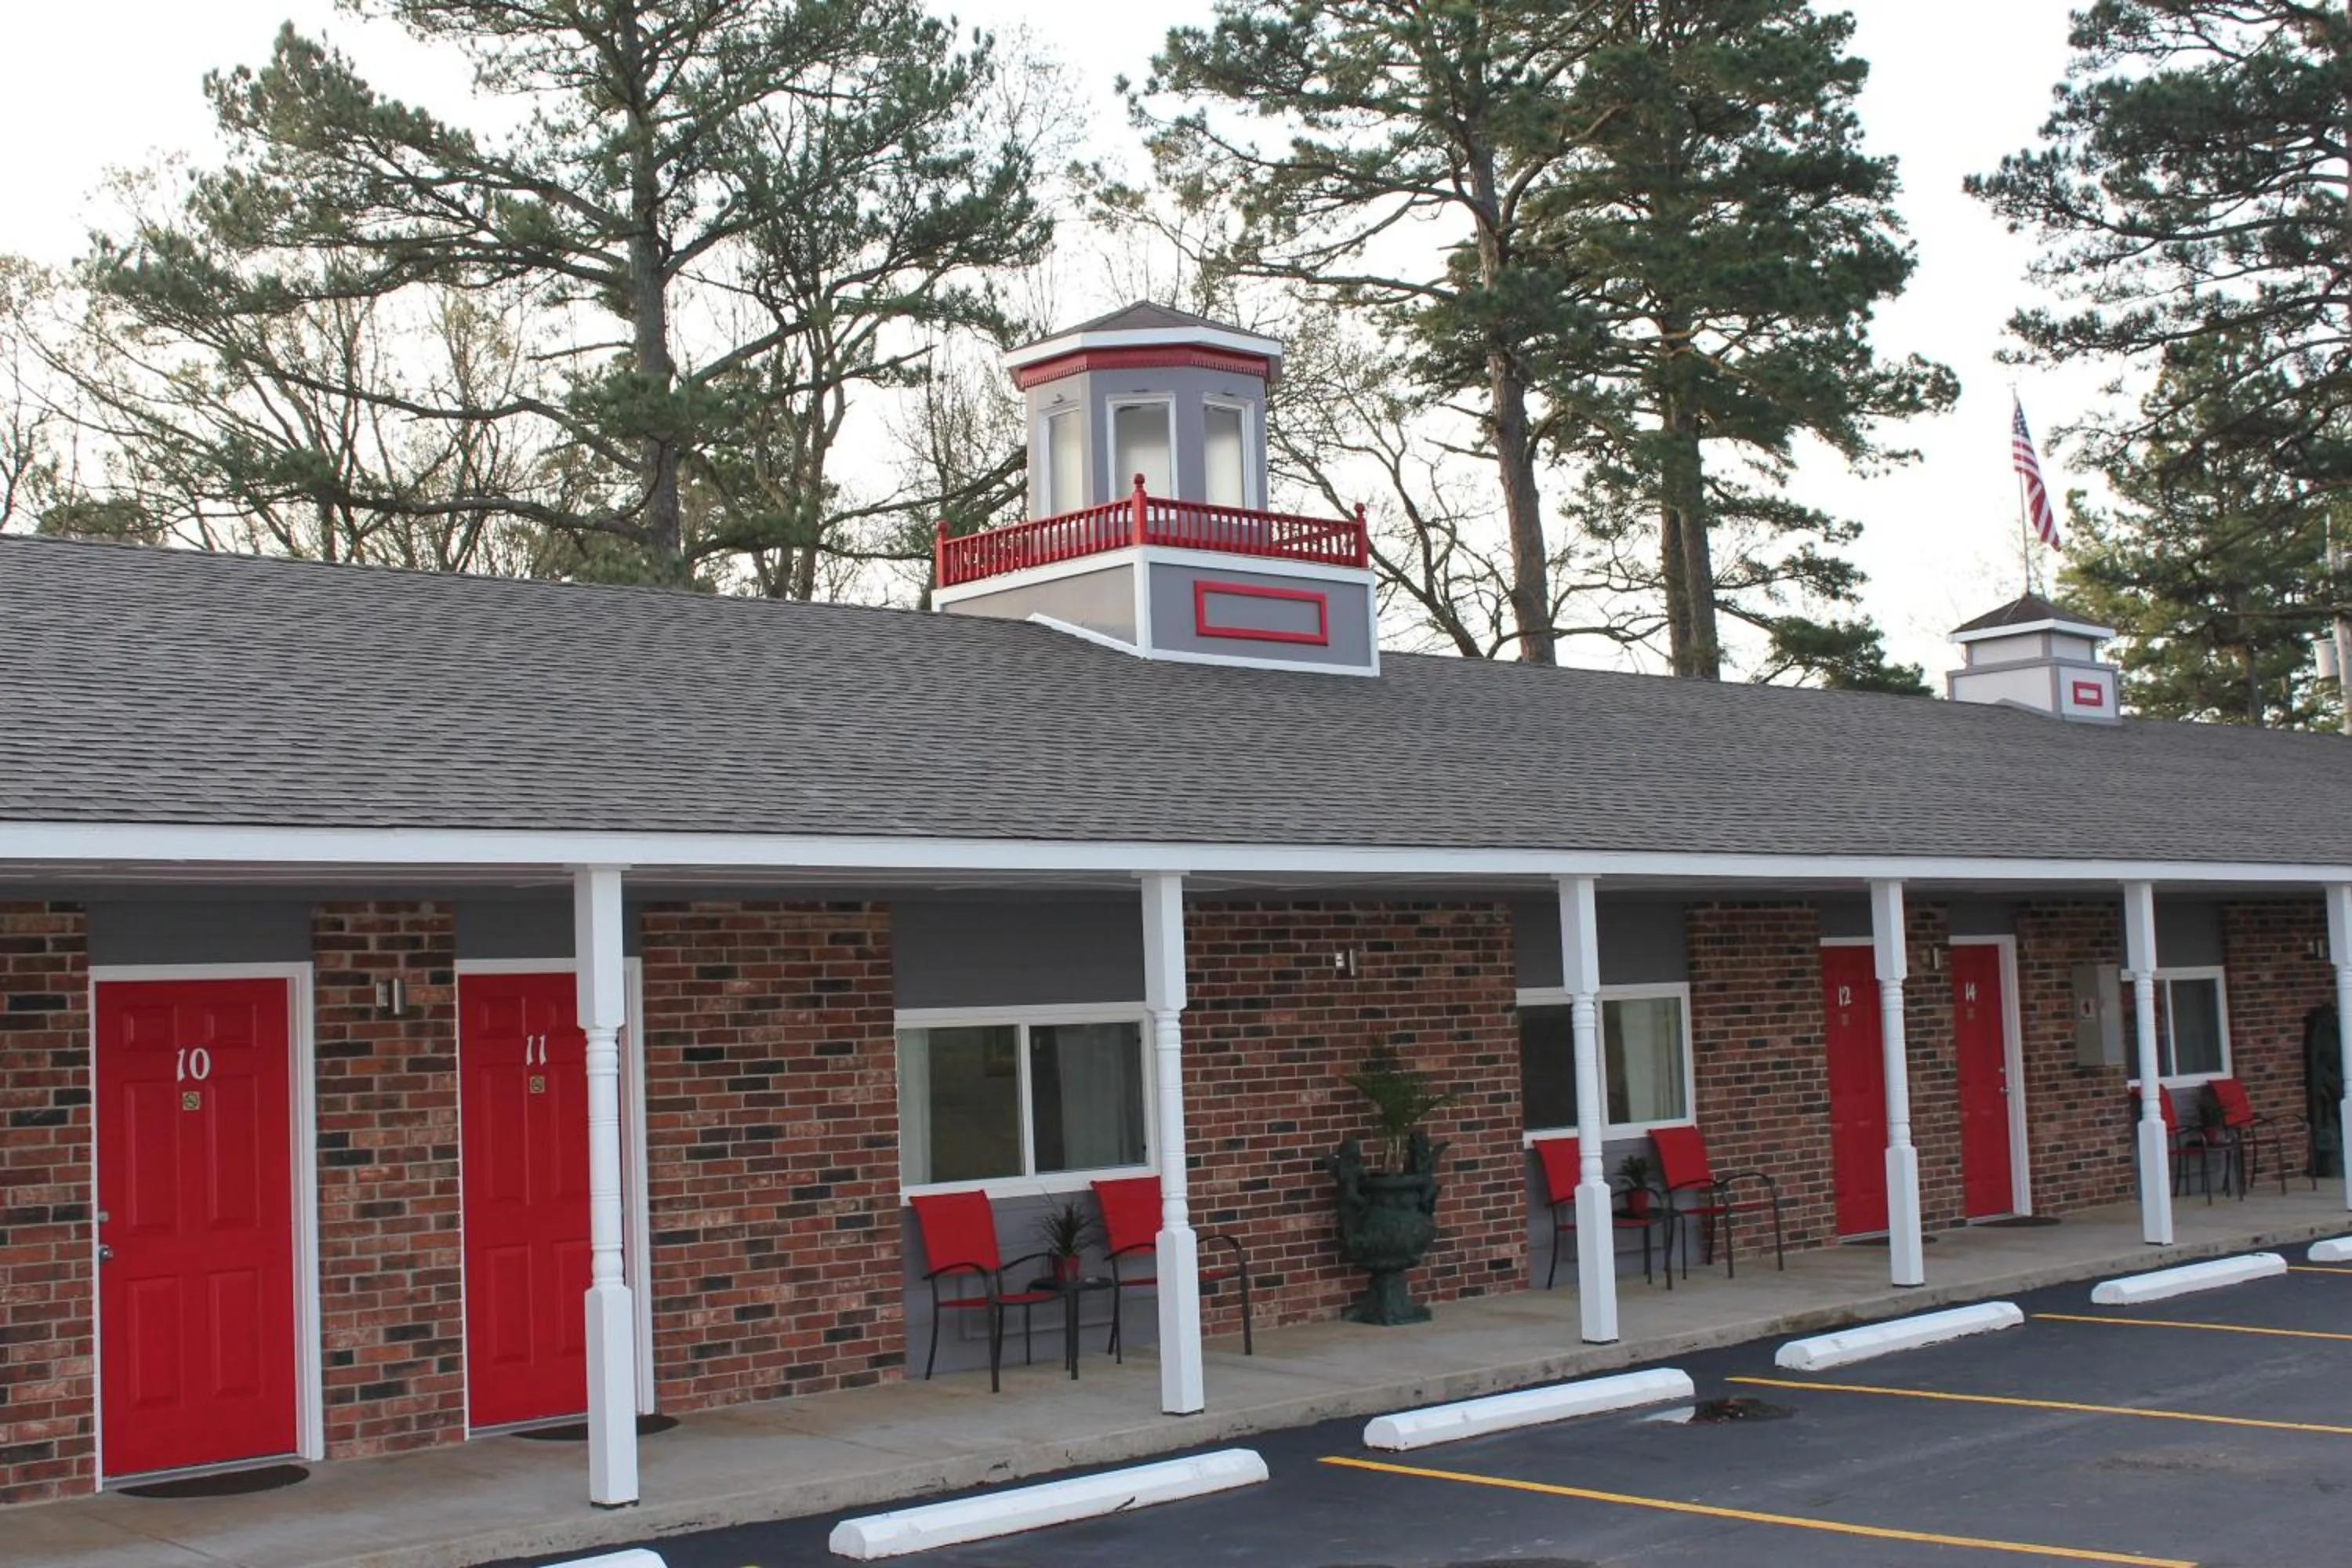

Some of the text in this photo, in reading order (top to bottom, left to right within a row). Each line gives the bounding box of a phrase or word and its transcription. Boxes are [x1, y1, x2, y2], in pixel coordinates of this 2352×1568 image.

[1838, 985, 1851, 1007] 12
[1965, 982, 1976, 1003] 14
[526, 1034, 546, 1065] 11
[176, 1047, 210, 1082] 10
